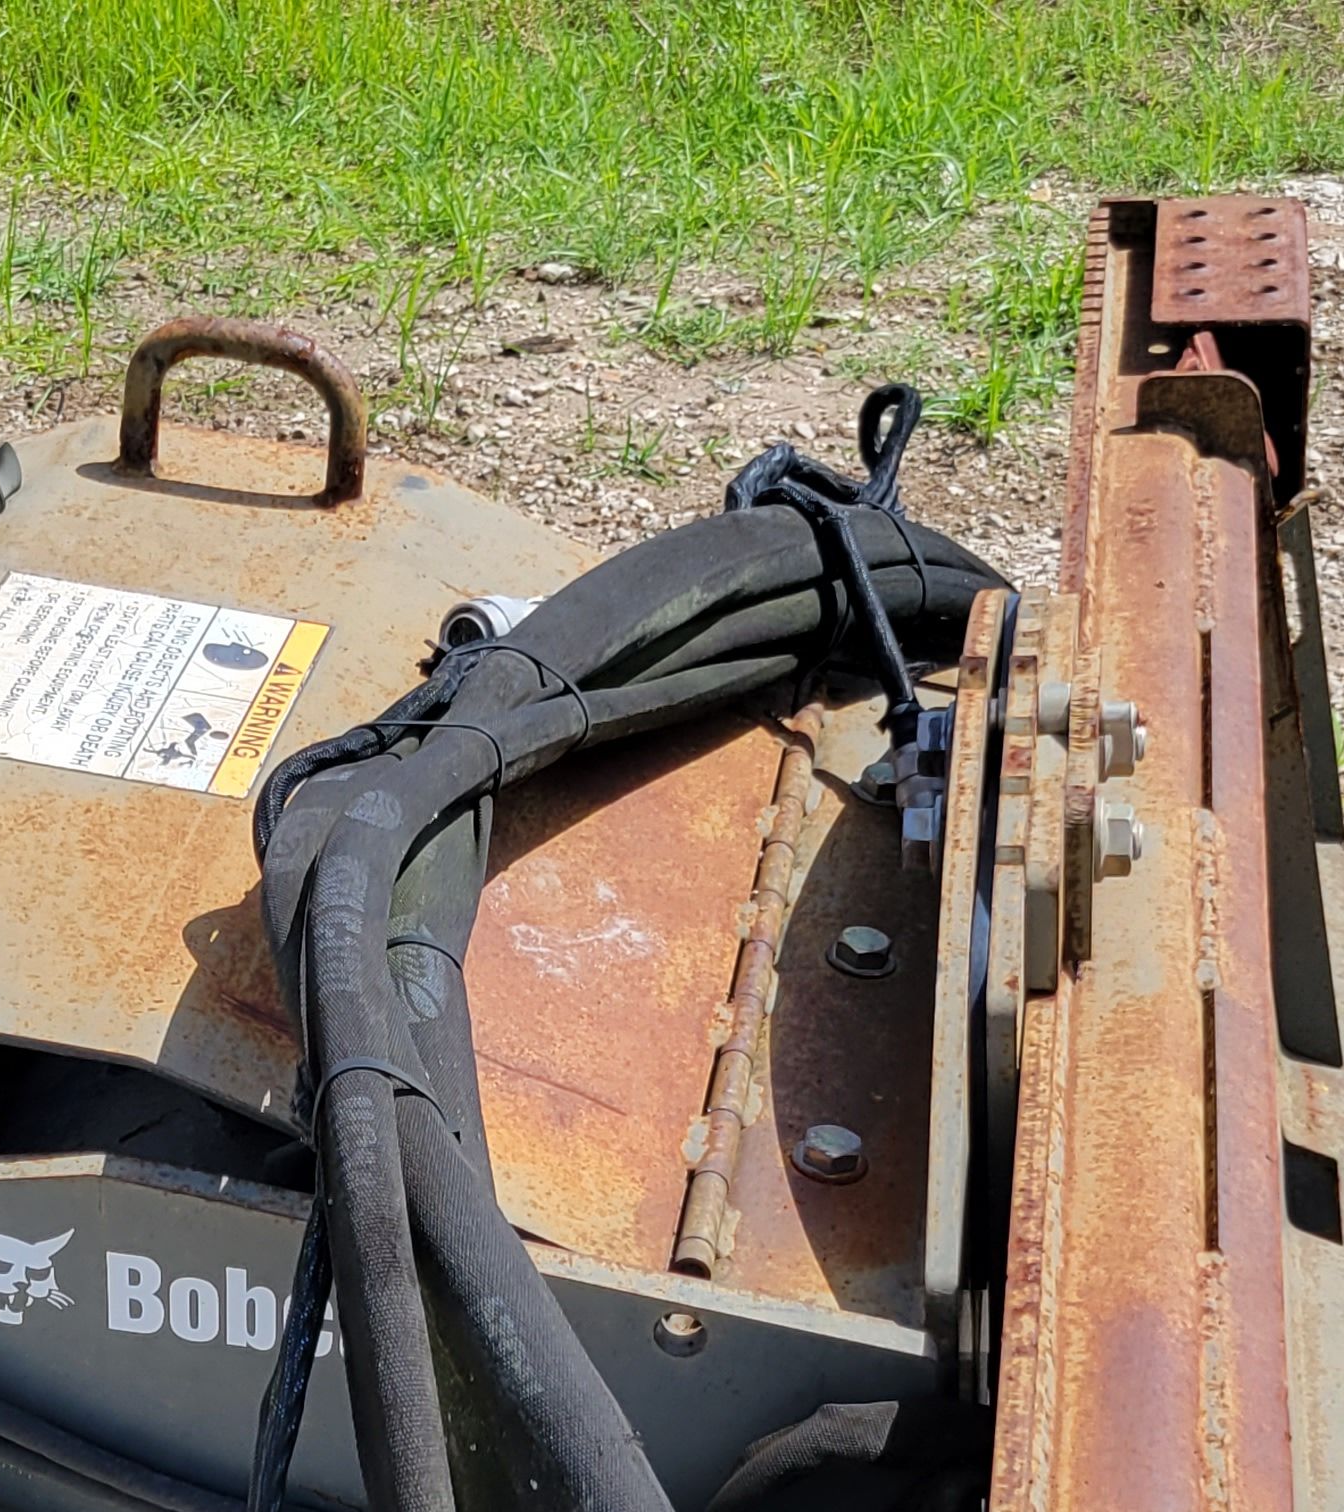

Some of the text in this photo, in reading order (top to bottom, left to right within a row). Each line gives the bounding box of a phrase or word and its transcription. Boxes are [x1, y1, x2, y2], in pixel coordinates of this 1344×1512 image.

[41, 591, 62, 604] OR
[60, 595, 86, 616] STOP
[89, 600, 116, 623] FROM
[116, 604, 140, 623] STAY
[41, 615, 73, 644] ENGINE
[109, 623, 128, 635] AT
[61, 623, 101, 667] OPERATING
[94, 633, 122, 659] LEAST
[20, 644, 54, 676] BEFORE
[87, 659, 106, 670] 10
[67, 602, 183, 767] PARTS CAN CAUSE INJURY OR DEATH
[75, 668, 100, 689] FEET
[102, 614, 201, 759] FLYING OBJECTS AND ROTATING
[48, 706, 76, 732] AWAY
[230, 679, 295, 760] WARNING
[106, 1250, 345, 1357] Bob
